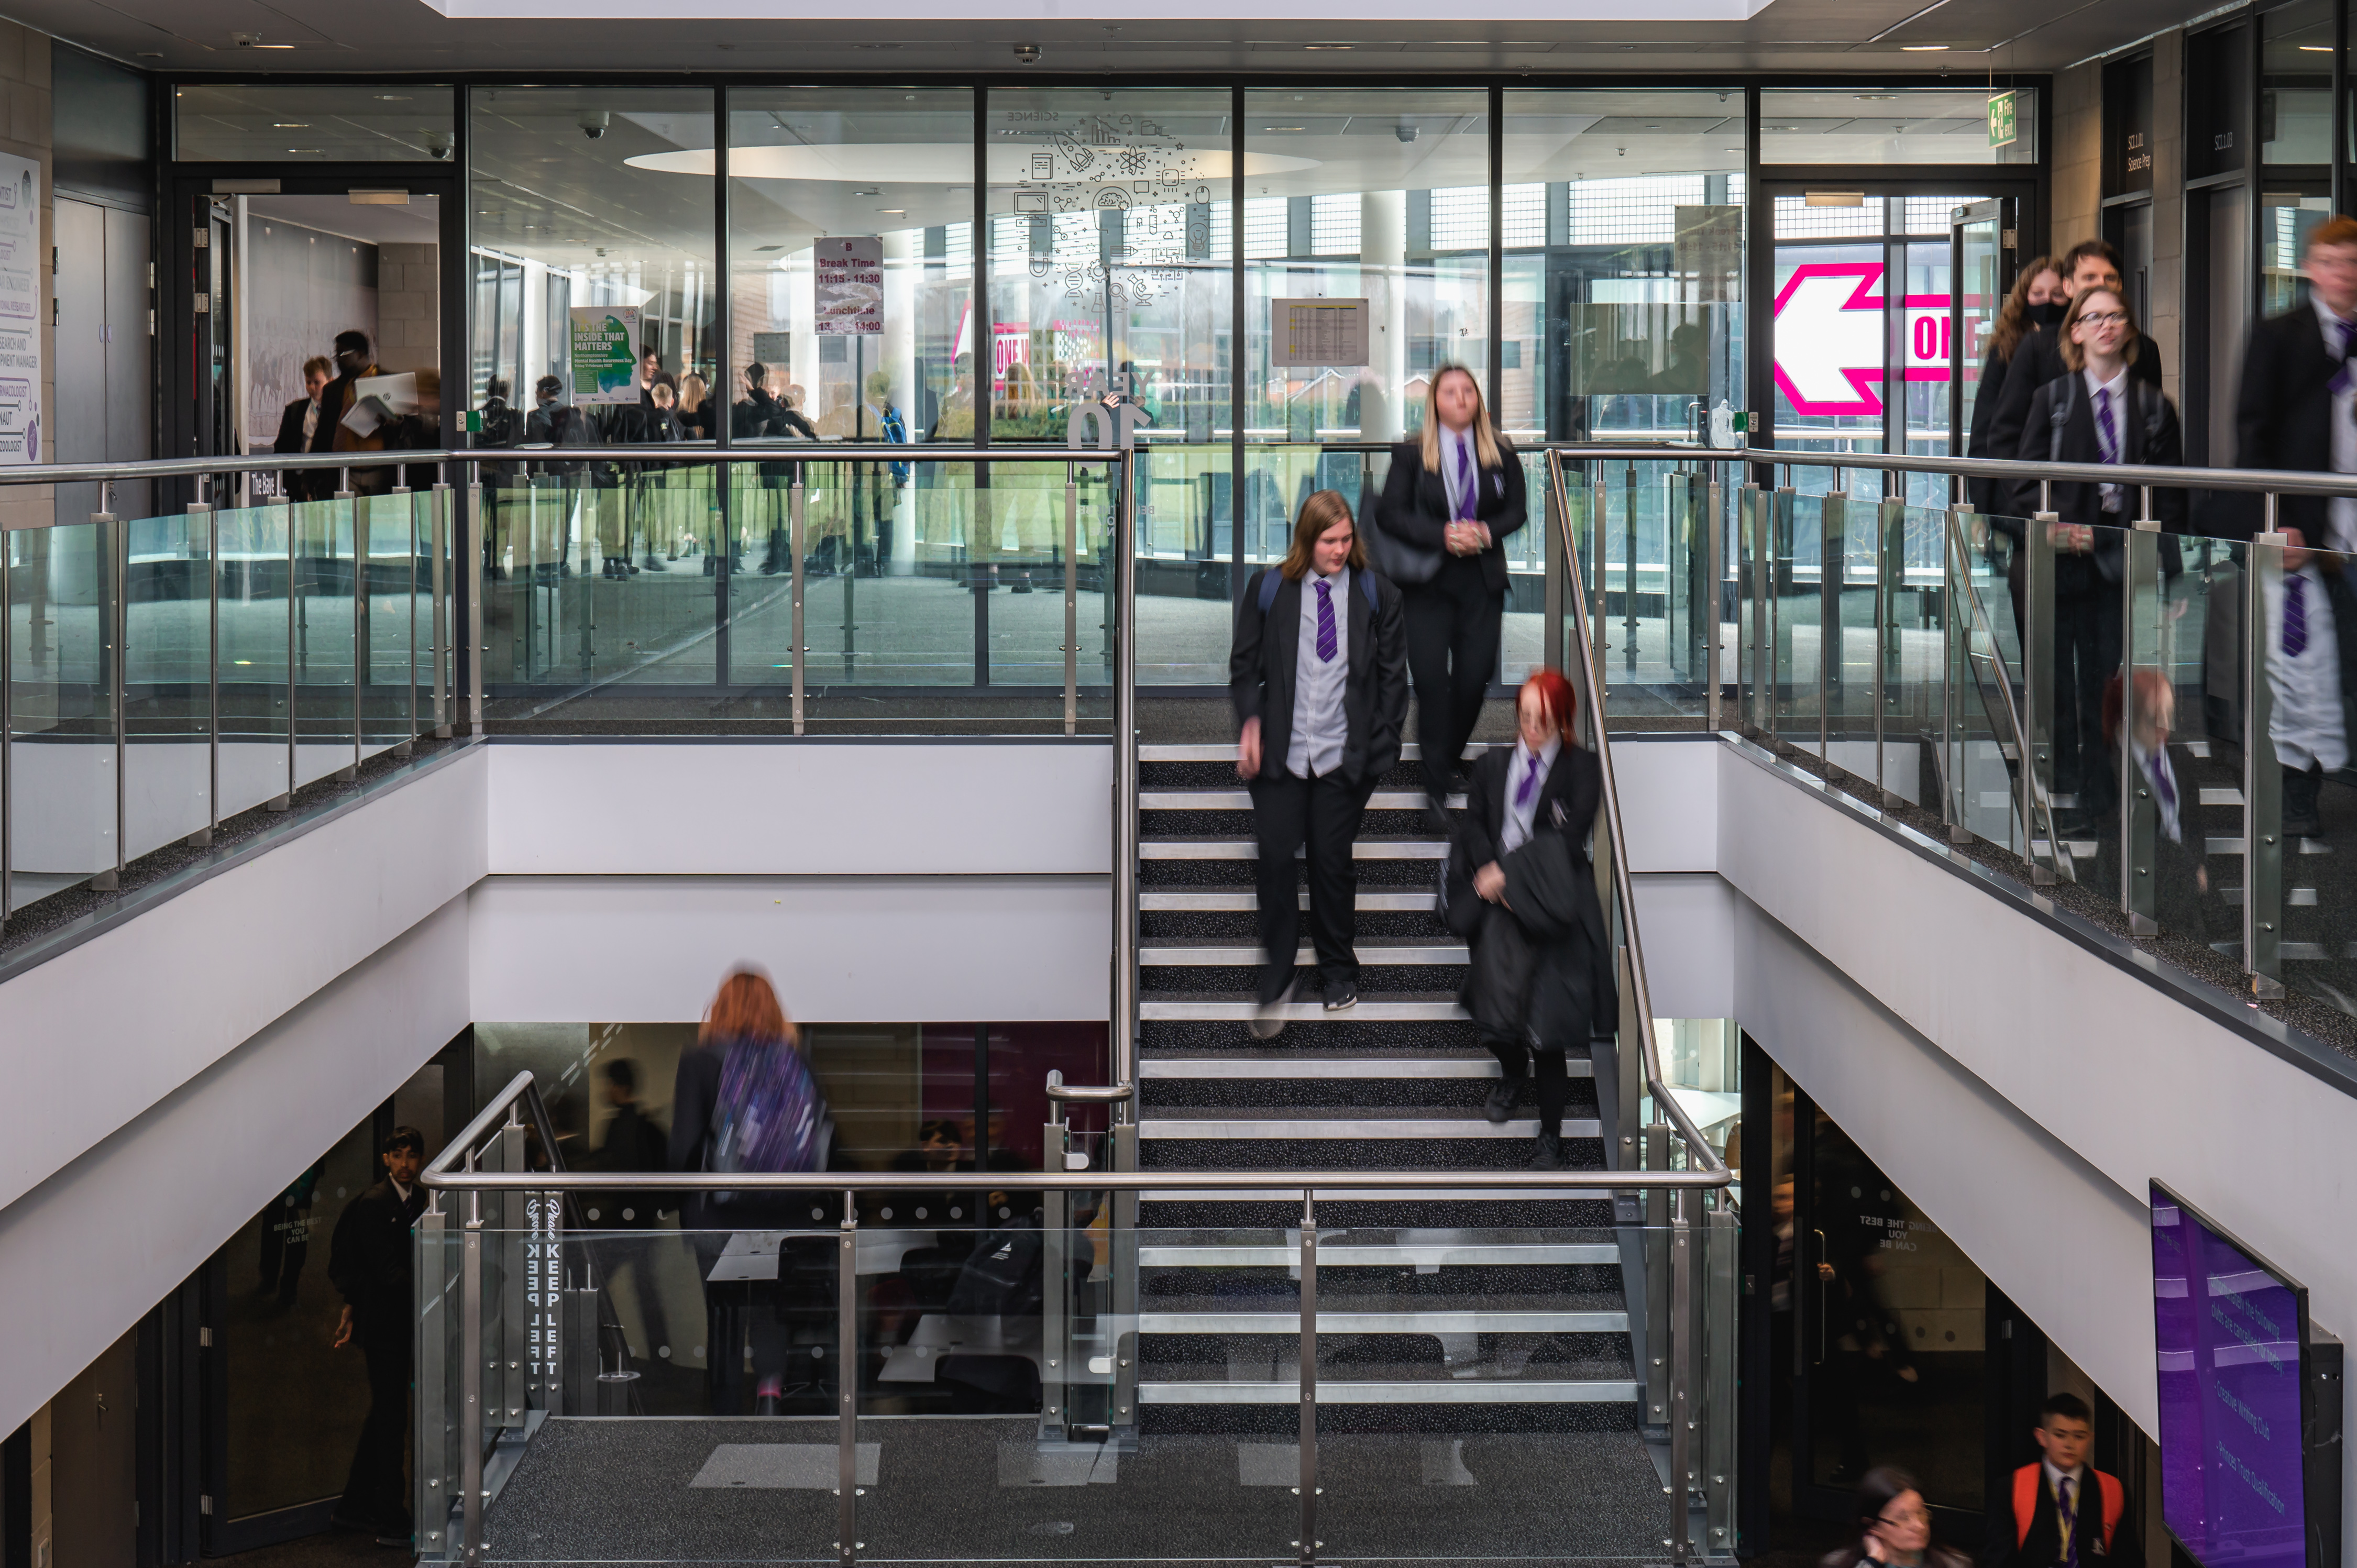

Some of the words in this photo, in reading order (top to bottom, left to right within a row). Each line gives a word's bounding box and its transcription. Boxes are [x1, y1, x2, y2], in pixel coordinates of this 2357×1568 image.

[2004, 119, 2013, 137] exit
[2129, 132, 2143, 150] SCI.1.01
[2215, 132, 2233, 151] SCI.1.03
[2128, 157, 2142, 171] Science
[2142, 153, 2151, 170] Prep
[845, 242, 852, 251] B
[820, 259, 848, 267] Break
[851, 259, 875, 267] Time
[819, 274, 845, 283] 11:15
[854, 274, 880, 283] 11:30
[10, 301, 31, 313] RESEARCHER
[574, 323, 589, 332] IT'S
[592, 323, 607, 332] THE
[855, 322, 880, 330] 14:00
[17, 337, 26, 351] AND
[574, 332, 602, 341] INSIDE
[604, 332, 625, 341] THAT
[574, 342, 612, 351] MATTERS
[16, 354, 37, 369] MANAGER
[251, 472, 262, 495] The
[274, 1221, 293, 1231] BEING
[294, 1219, 305, 1228] THE
[307, 1217, 322, 1225] BEST
[546, 1199, 560, 1241] Please
[292, 1227, 304, 1235] YOU
[546, 1244, 560, 1307] KEEP
[2210, 1271, 2244, 1316] Unfortunately
[2245, 1298, 2254, 1320] the
[2255, 1304, 2280, 1344] following
[2211, 1301, 2224, 1326] clubs
[2224, 1315, 2233, 1333] are
[2233, 1322, 2257, 1353] cancelled
[547, 1313, 557, 1375] LEFT
[2217, 1380, 2237, 1412] Creative
[2238, 1398, 2257, 1434] Writing
[2258, 1416, 2270, 1441] Club
[2219, 1440, 2237, 1471] Princes
[2237, 1457, 2251, 1484] Trust
[2252, 1471, 2285, 1517] Qualification
